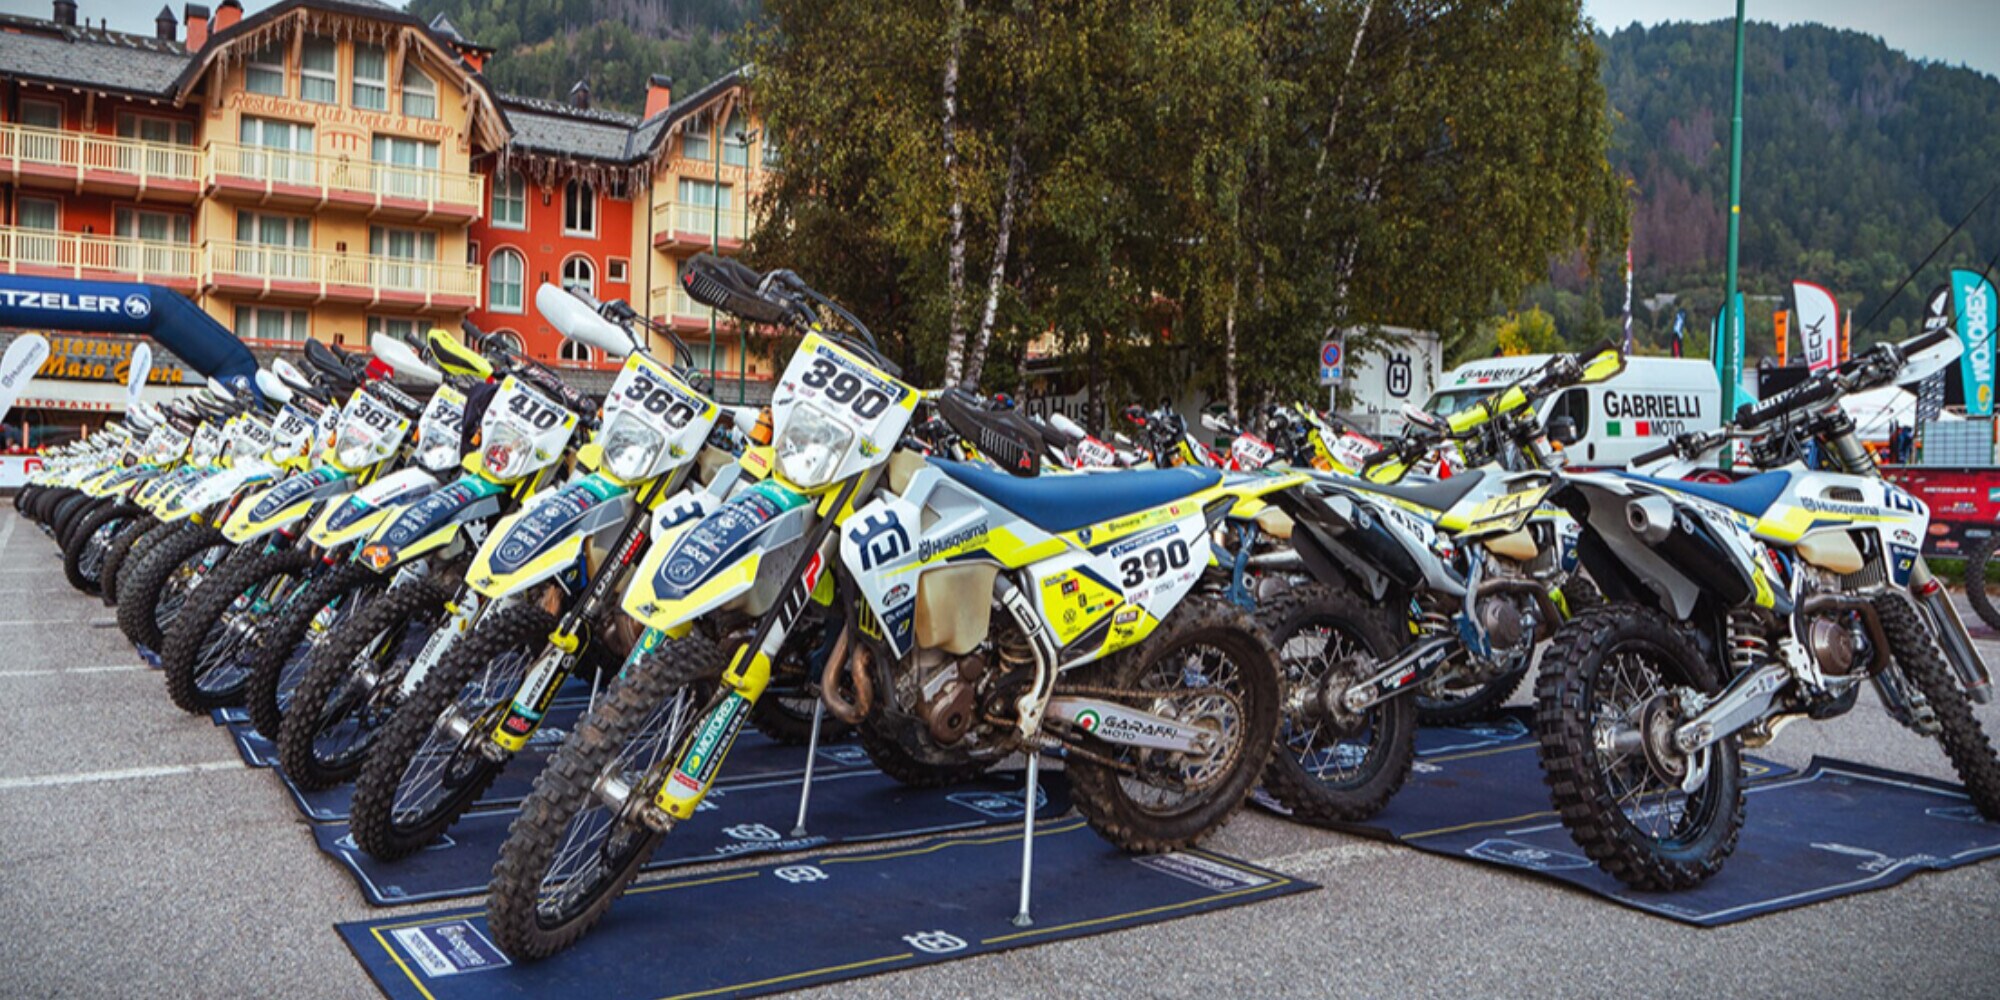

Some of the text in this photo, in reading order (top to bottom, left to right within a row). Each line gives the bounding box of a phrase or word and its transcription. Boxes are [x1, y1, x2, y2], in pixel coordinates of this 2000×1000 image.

[0, 289, 121, 313] TZELER
[1965, 282, 1991, 382] MOTOREX
[36, 354, 106, 377] Maso
[114, 358, 183, 386] Gera
[625, 375, 695, 430] 360
[802, 357, 890, 419] 390
[15, 398, 112, 411] ISTORANTE
[354, 402, 394, 433] 361
[508, 394, 559, 430] 410
[1603, 390, 1701, 418] GABRIELLI
[280, 415, 304, 436] 85
[1119, 538, 1191, 589] 390
[695, 696, 738, 756] MOTOREX
[1101, 727, 1137, 741] MOTO
[1104, 715, 1178, 739] GARAFFI
